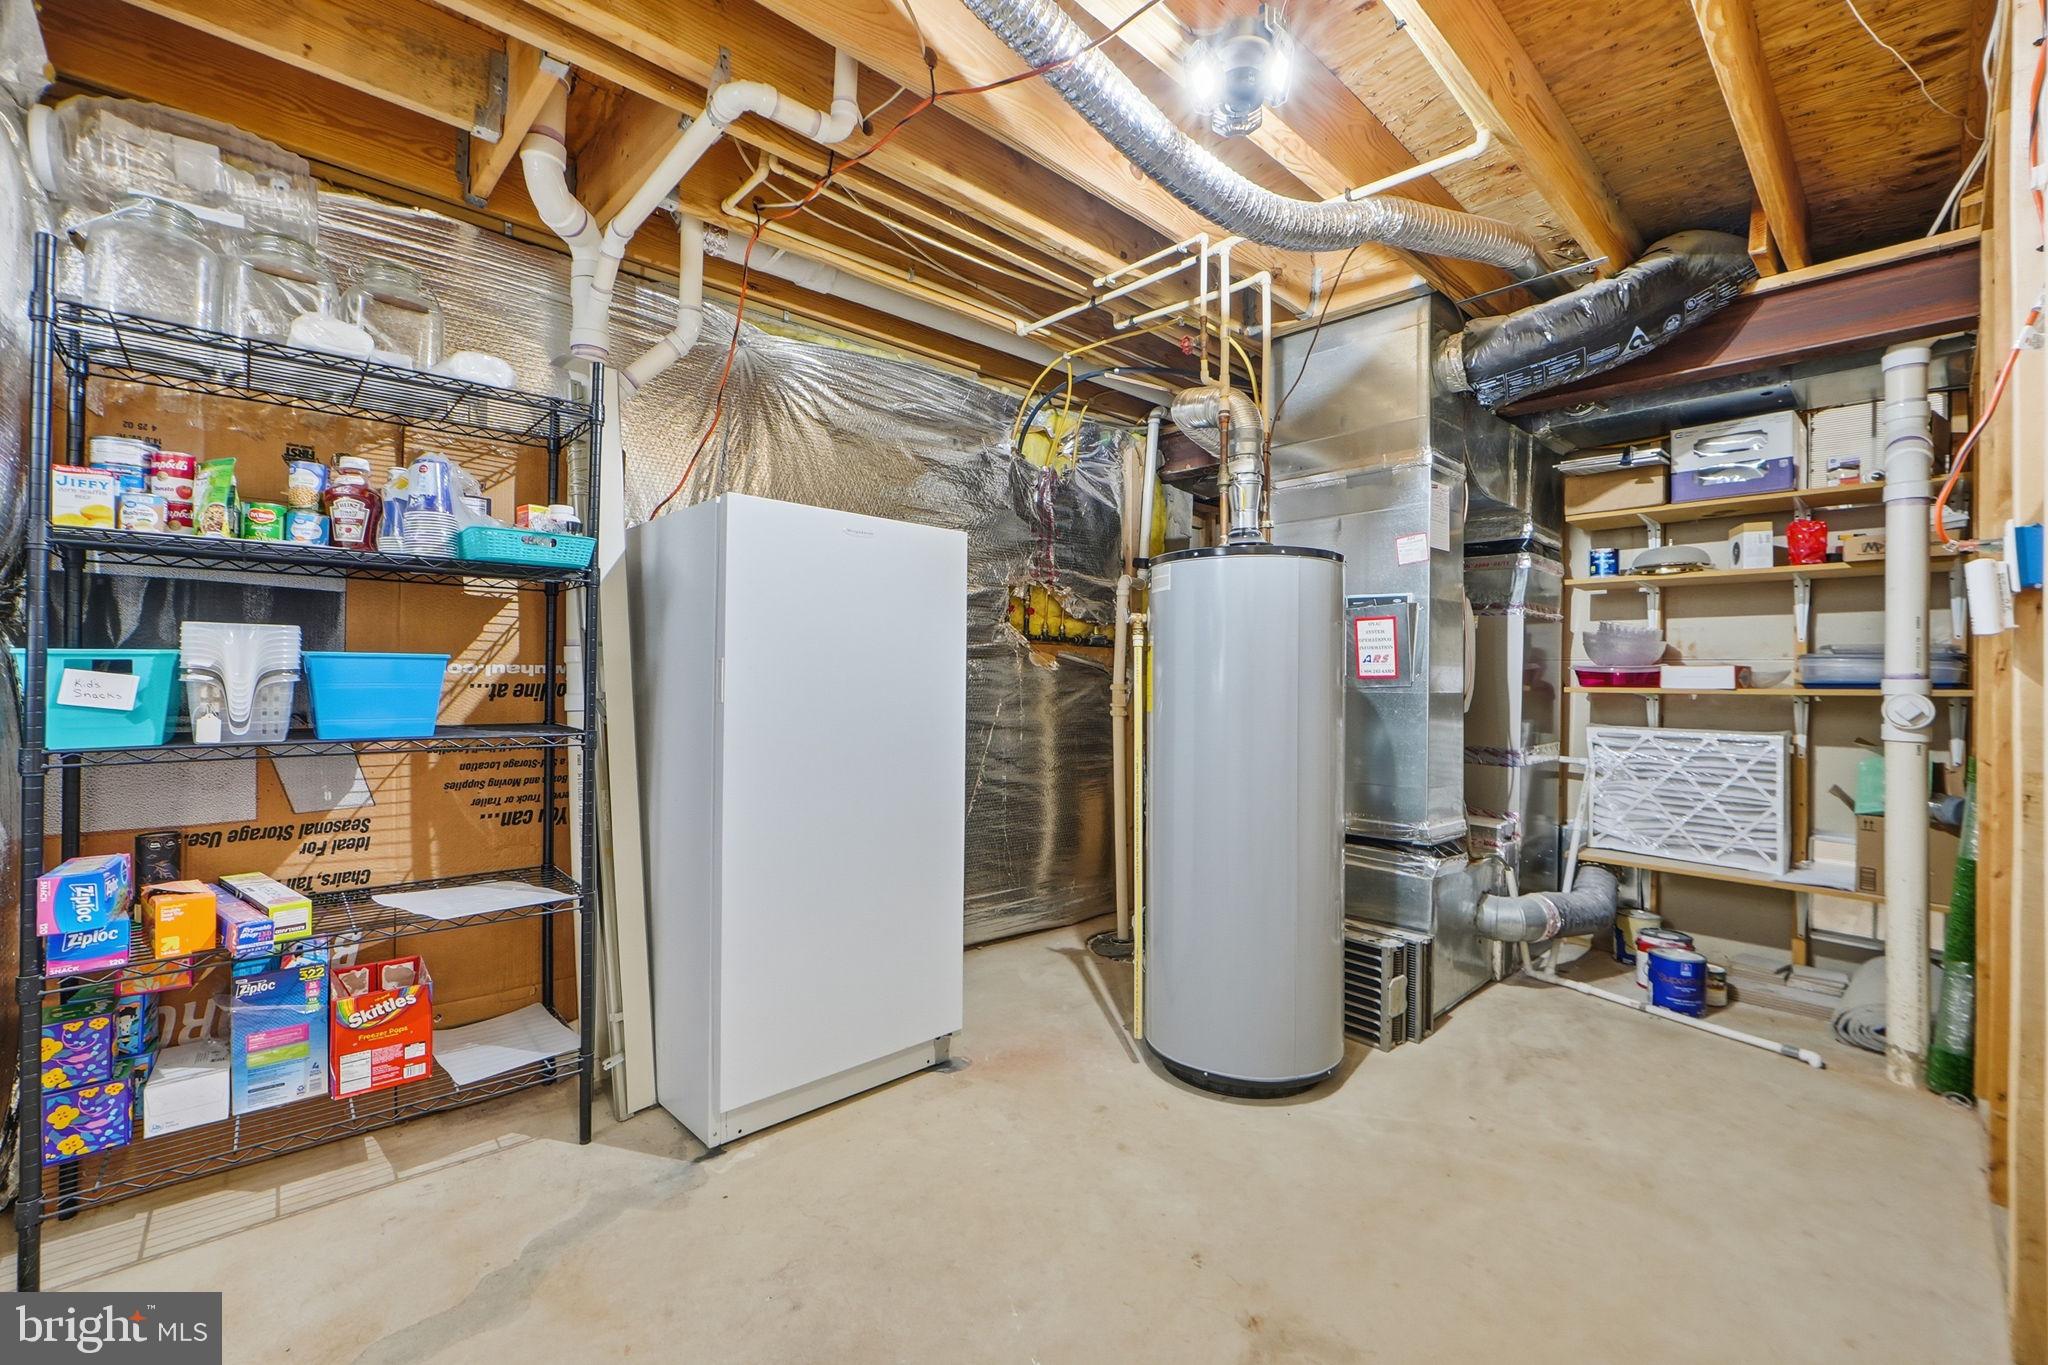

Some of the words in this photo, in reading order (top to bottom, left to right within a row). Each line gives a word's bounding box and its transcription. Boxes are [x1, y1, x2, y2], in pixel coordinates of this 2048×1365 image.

[56, 475, 109, 490] JIFFY
[1363, 654, 1389, 663] ARS
[73, 688, 122, 700] Snacks
[459, 760, 501, 772] Location
[443, 779, 486, 791] Supplies
[487, 777, 522, 788] Moving
[523, 777, 541, 786] and
[470, 797, 502, 808] Trailer
[503, 796, 515, 805] or
[518, 794, 541, 804] Truck
[227, 825, 295, 843] Storage
[298, 818, 372, 840] Seasonal
[184, 831, 223, 849] Use.
[330, 836, 371, 855] Ideal
[299, 841, 327, 857] For
[317, 868, 372, 888] Chairs,
[70, 885, 94, 923] Ziploc
[66, 929, 118, 950] Ziploc
[50, 966, 79, 975] SNACK
[238, 981, 276, 996] Ziploc
[348, 994, 417, 1029] Skittles
